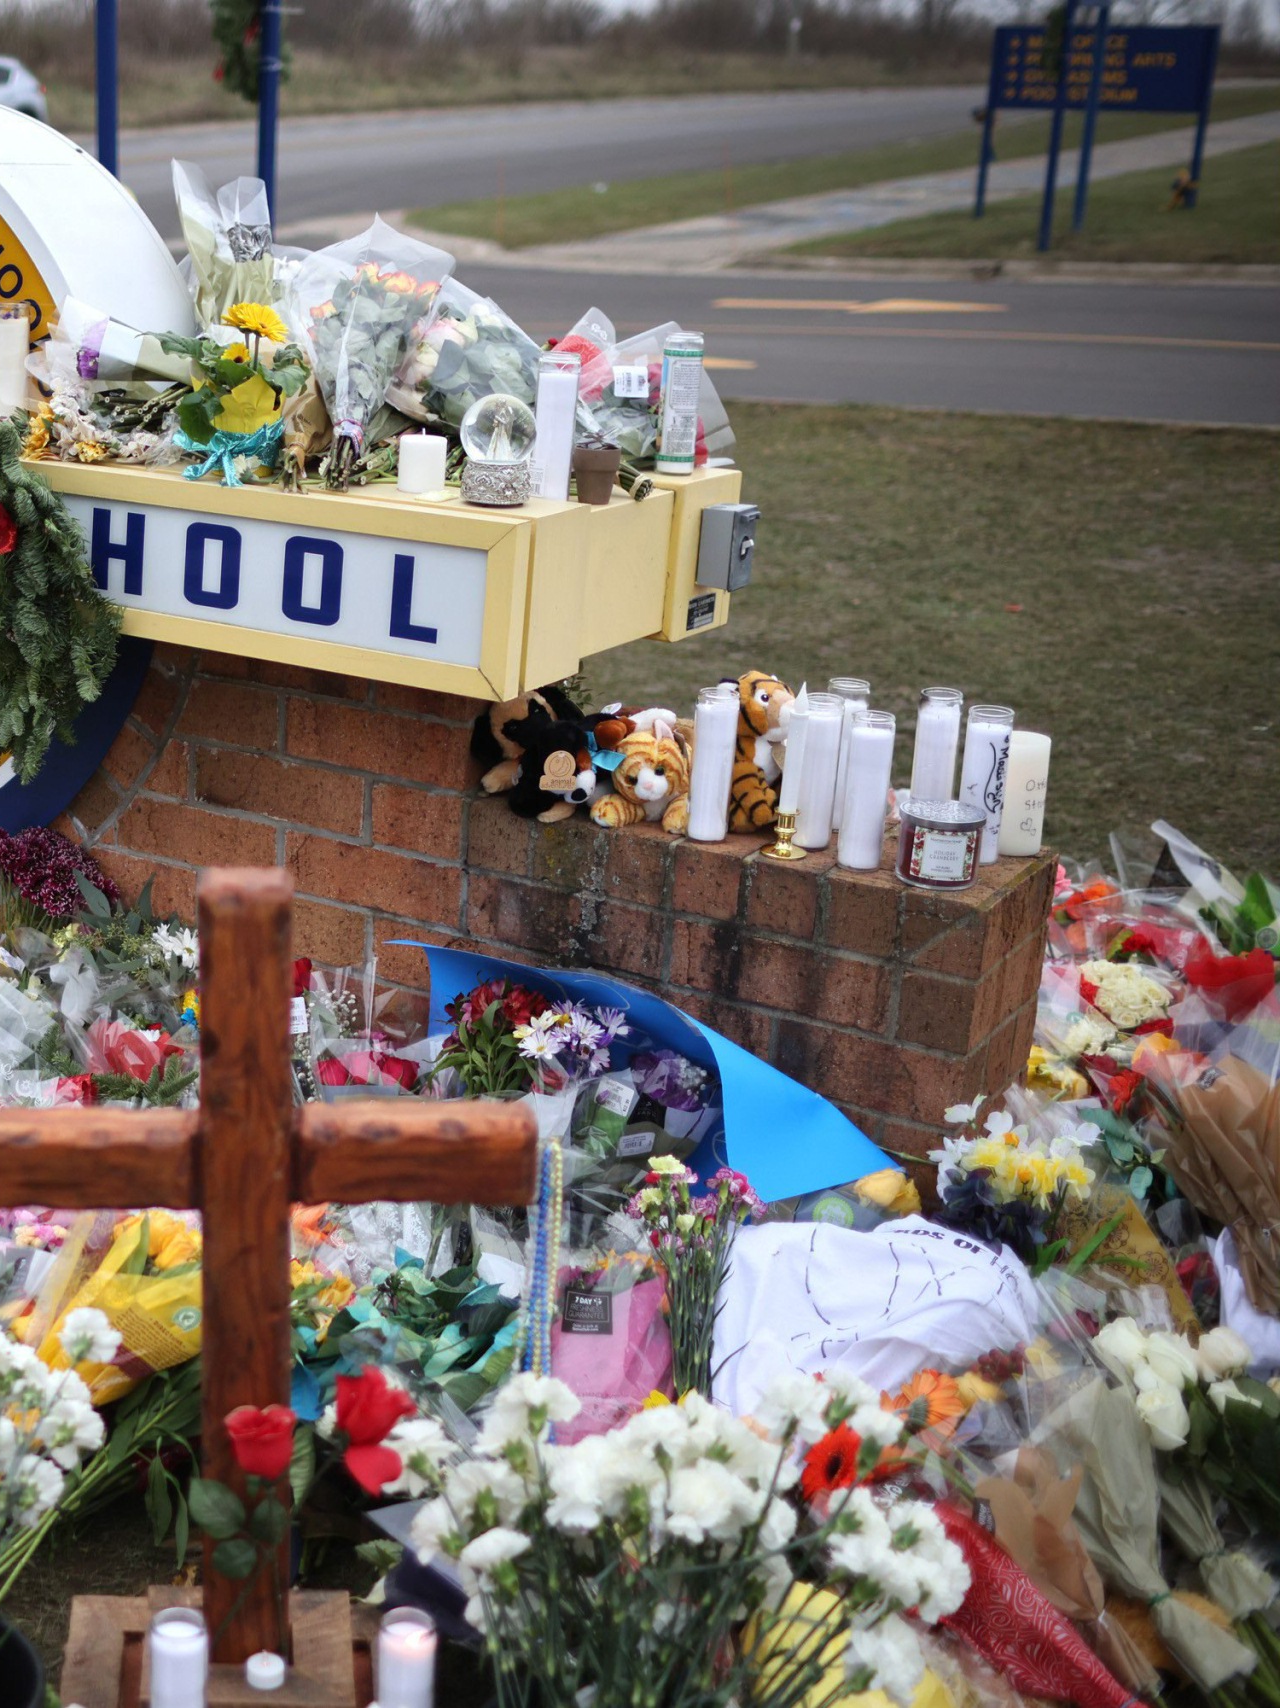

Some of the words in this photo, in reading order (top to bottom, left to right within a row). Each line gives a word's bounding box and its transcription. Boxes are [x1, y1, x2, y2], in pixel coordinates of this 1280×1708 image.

[91, 507, 438, 644] HOOL
[575, 1296, 580, 1304] 7
[579, 1297, 593, 1305] DAY
